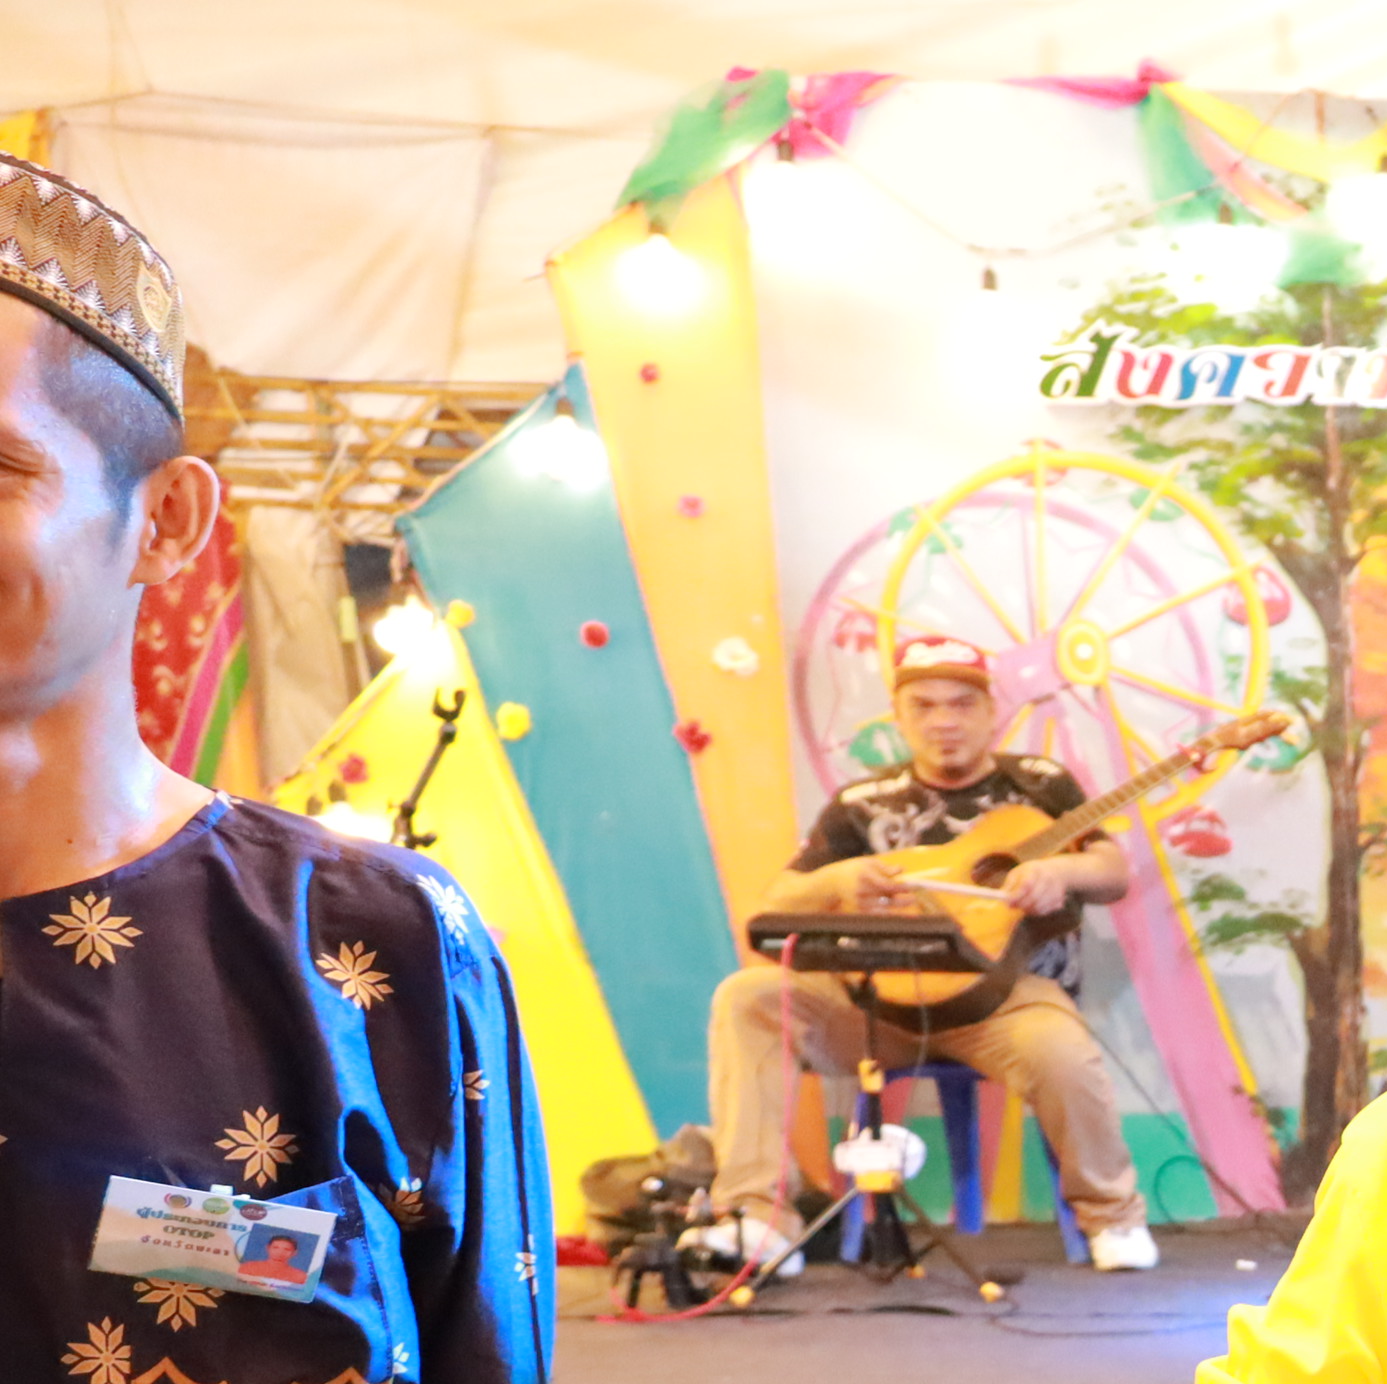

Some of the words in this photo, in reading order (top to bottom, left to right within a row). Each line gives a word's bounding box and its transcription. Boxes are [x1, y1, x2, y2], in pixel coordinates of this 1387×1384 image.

[137, 1206, 248, 1233] ผู้ประกอบการ
[163, 1225, 215, 1240] OTOP
